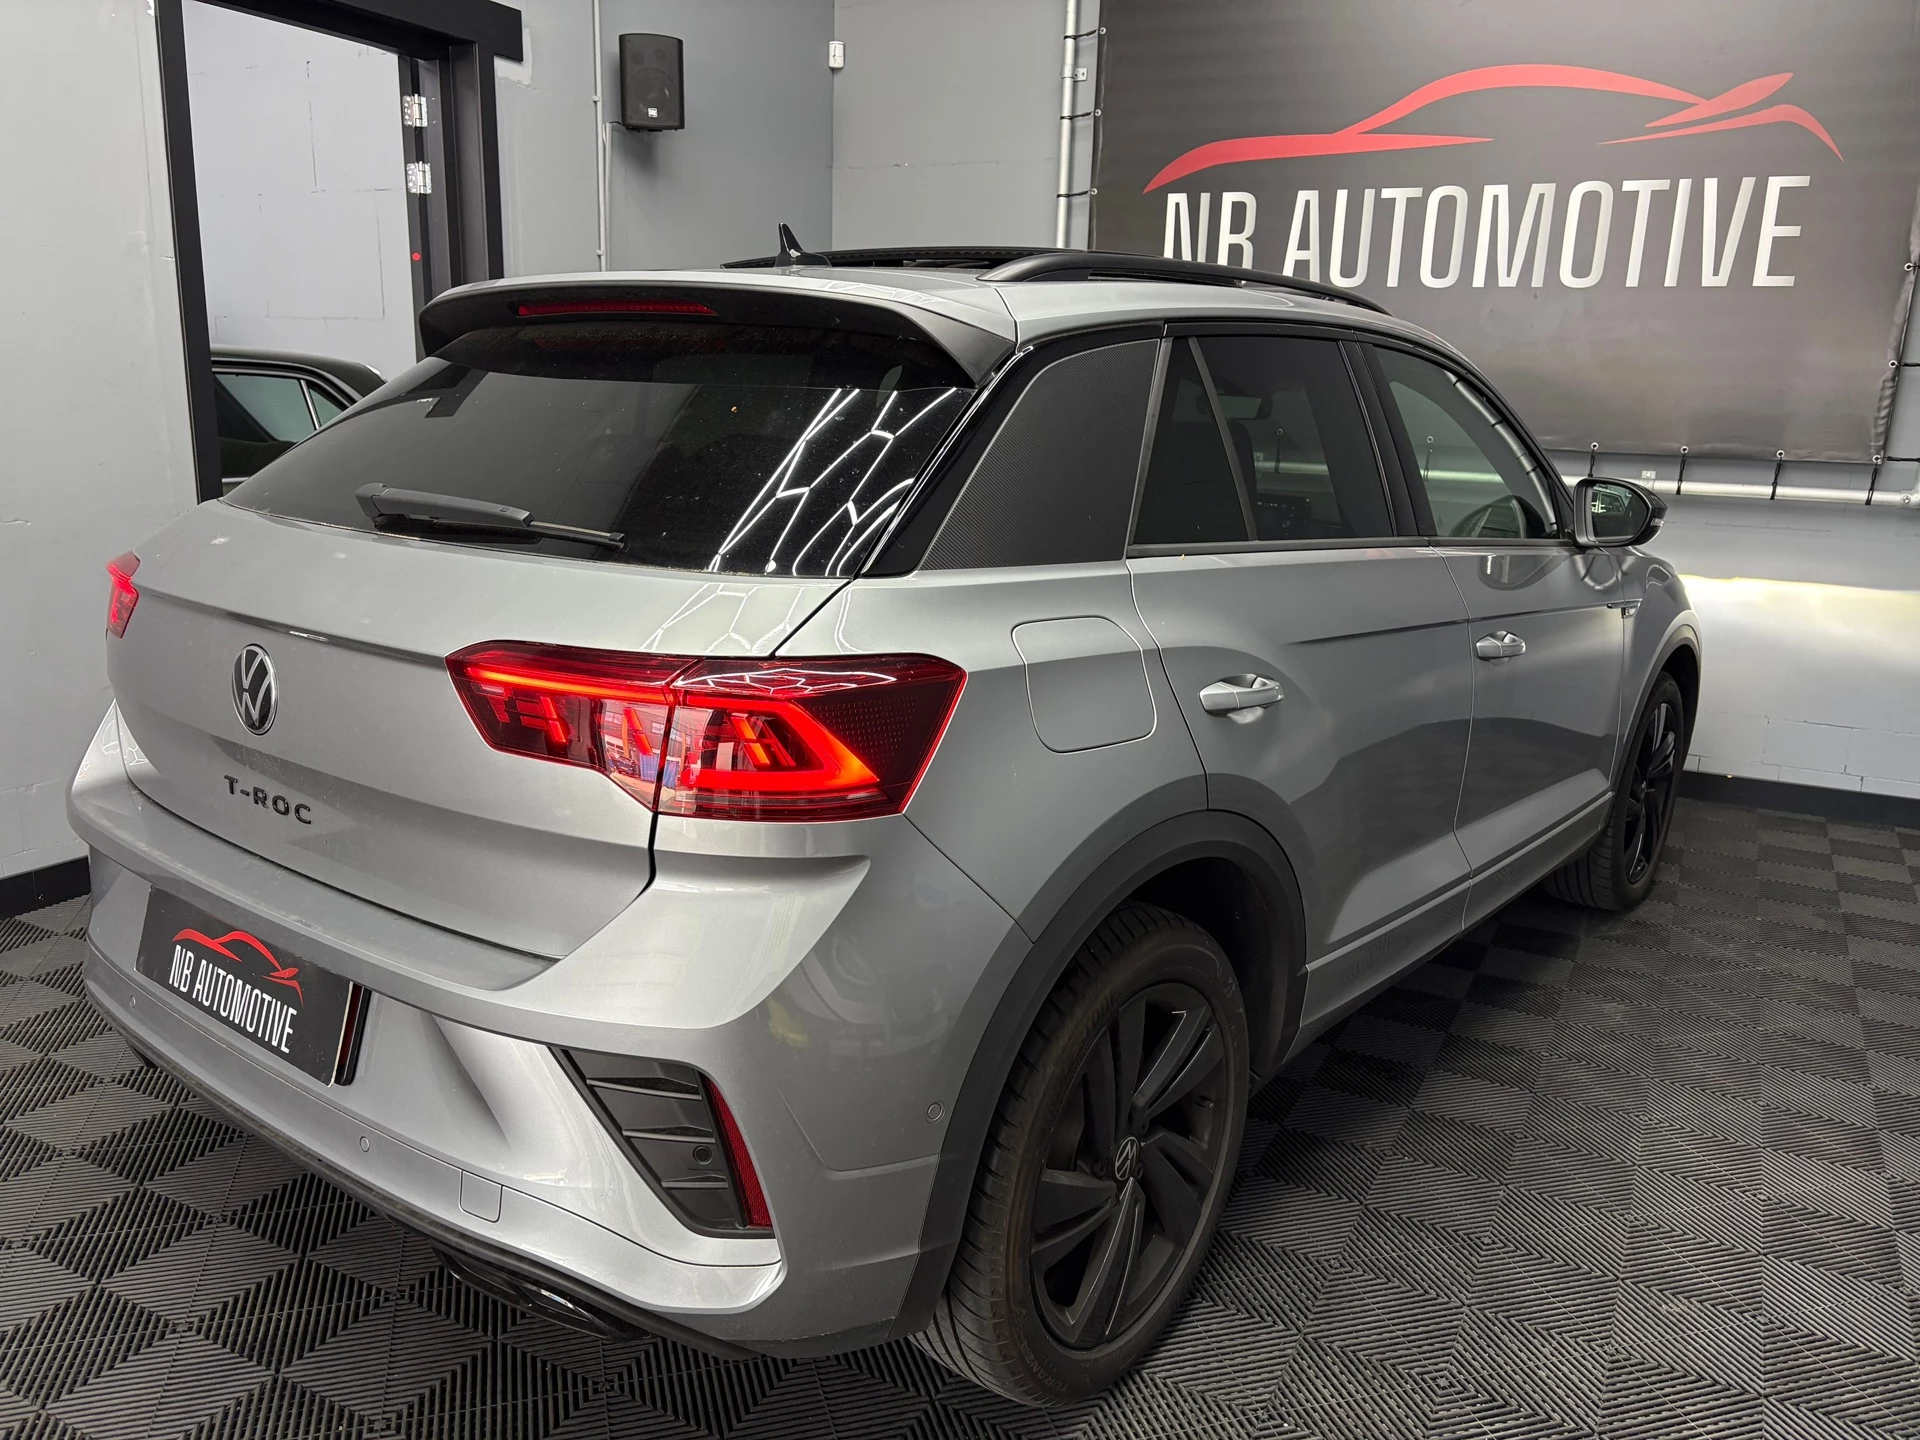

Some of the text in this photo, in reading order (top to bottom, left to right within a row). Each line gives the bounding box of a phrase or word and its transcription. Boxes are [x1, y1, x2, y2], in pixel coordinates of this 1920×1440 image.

[1163, 174, 1811, 289] NB AUTOMOTIVE
[224, 774, 312, 825] T-ROC
[168, 944, 298, 1054] NB AUTOMOTIVE
